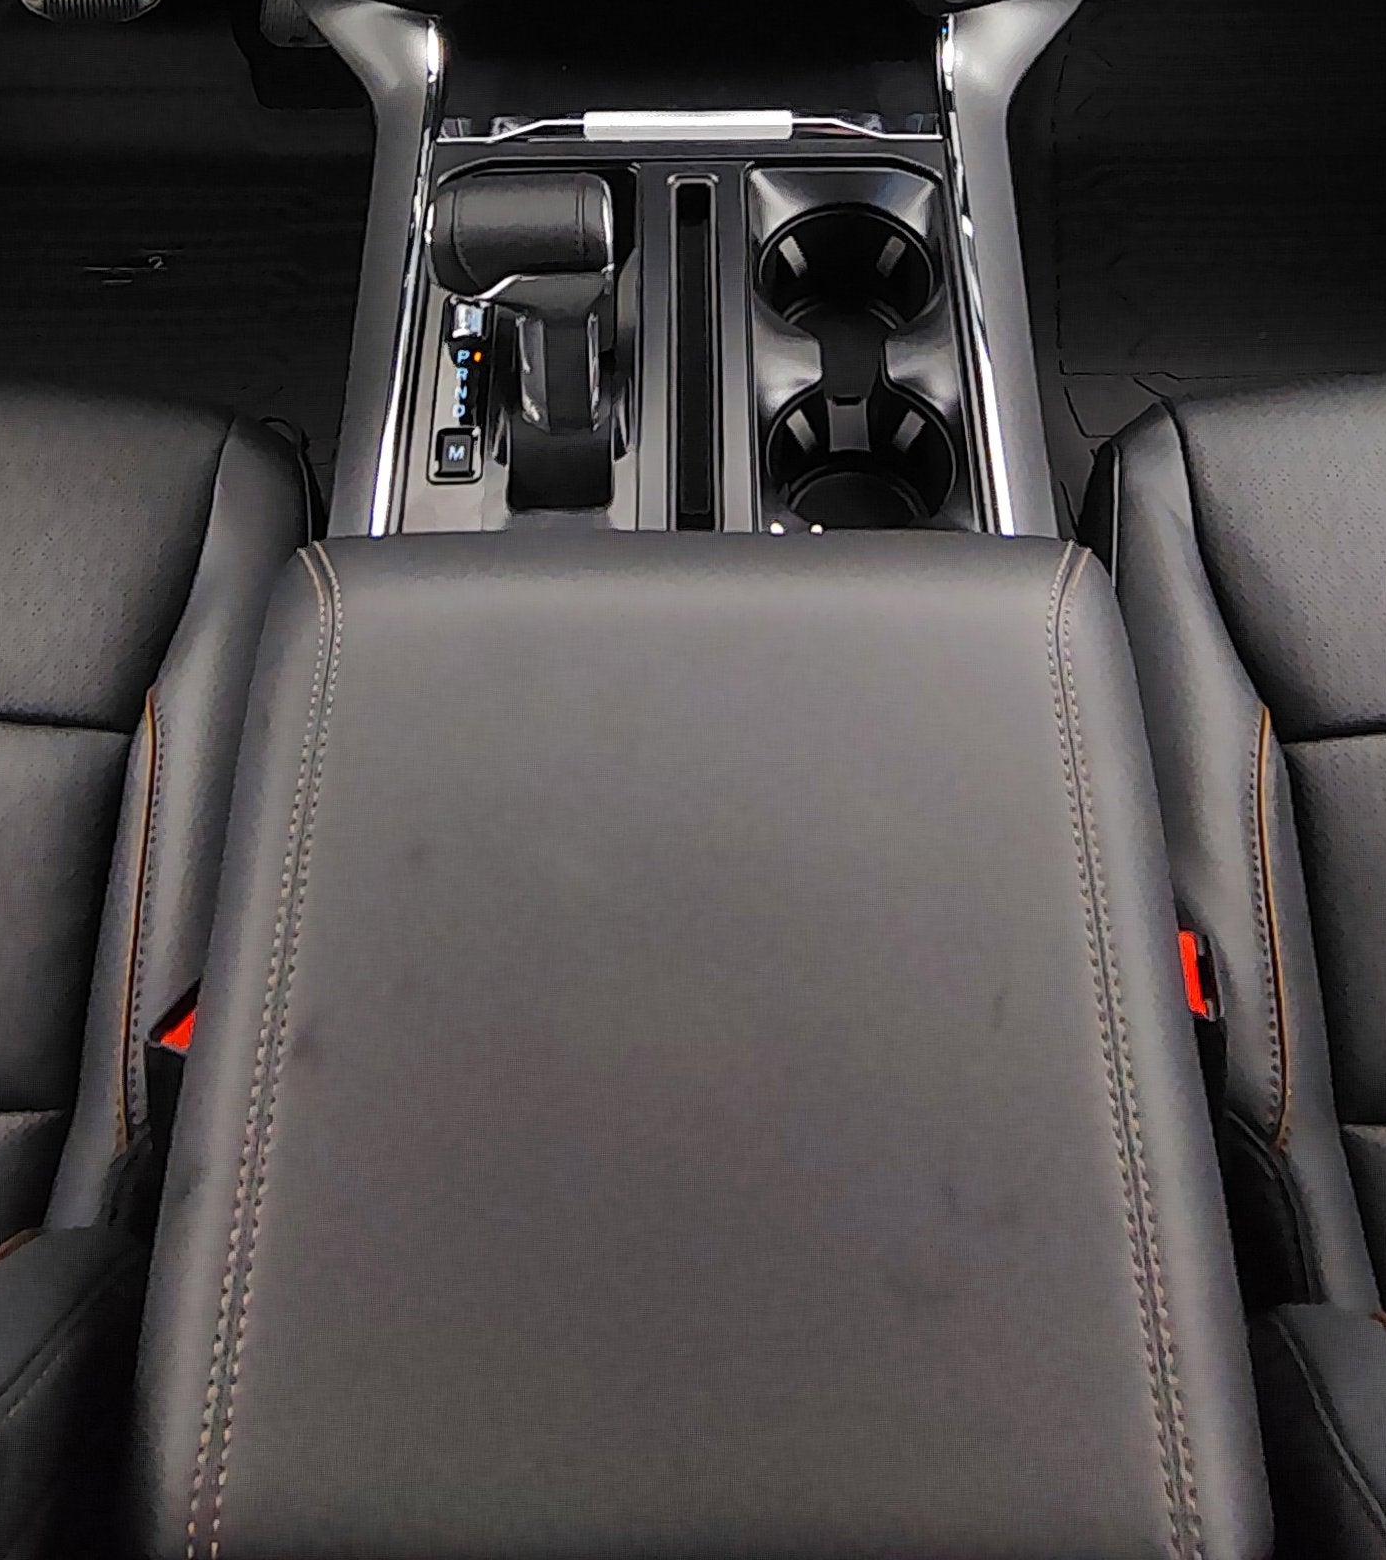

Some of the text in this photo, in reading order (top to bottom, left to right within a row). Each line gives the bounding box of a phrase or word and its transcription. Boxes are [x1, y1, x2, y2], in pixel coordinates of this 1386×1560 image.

[452, 349, 470, 418] P R N D
[447, 444, 466, 462] M
